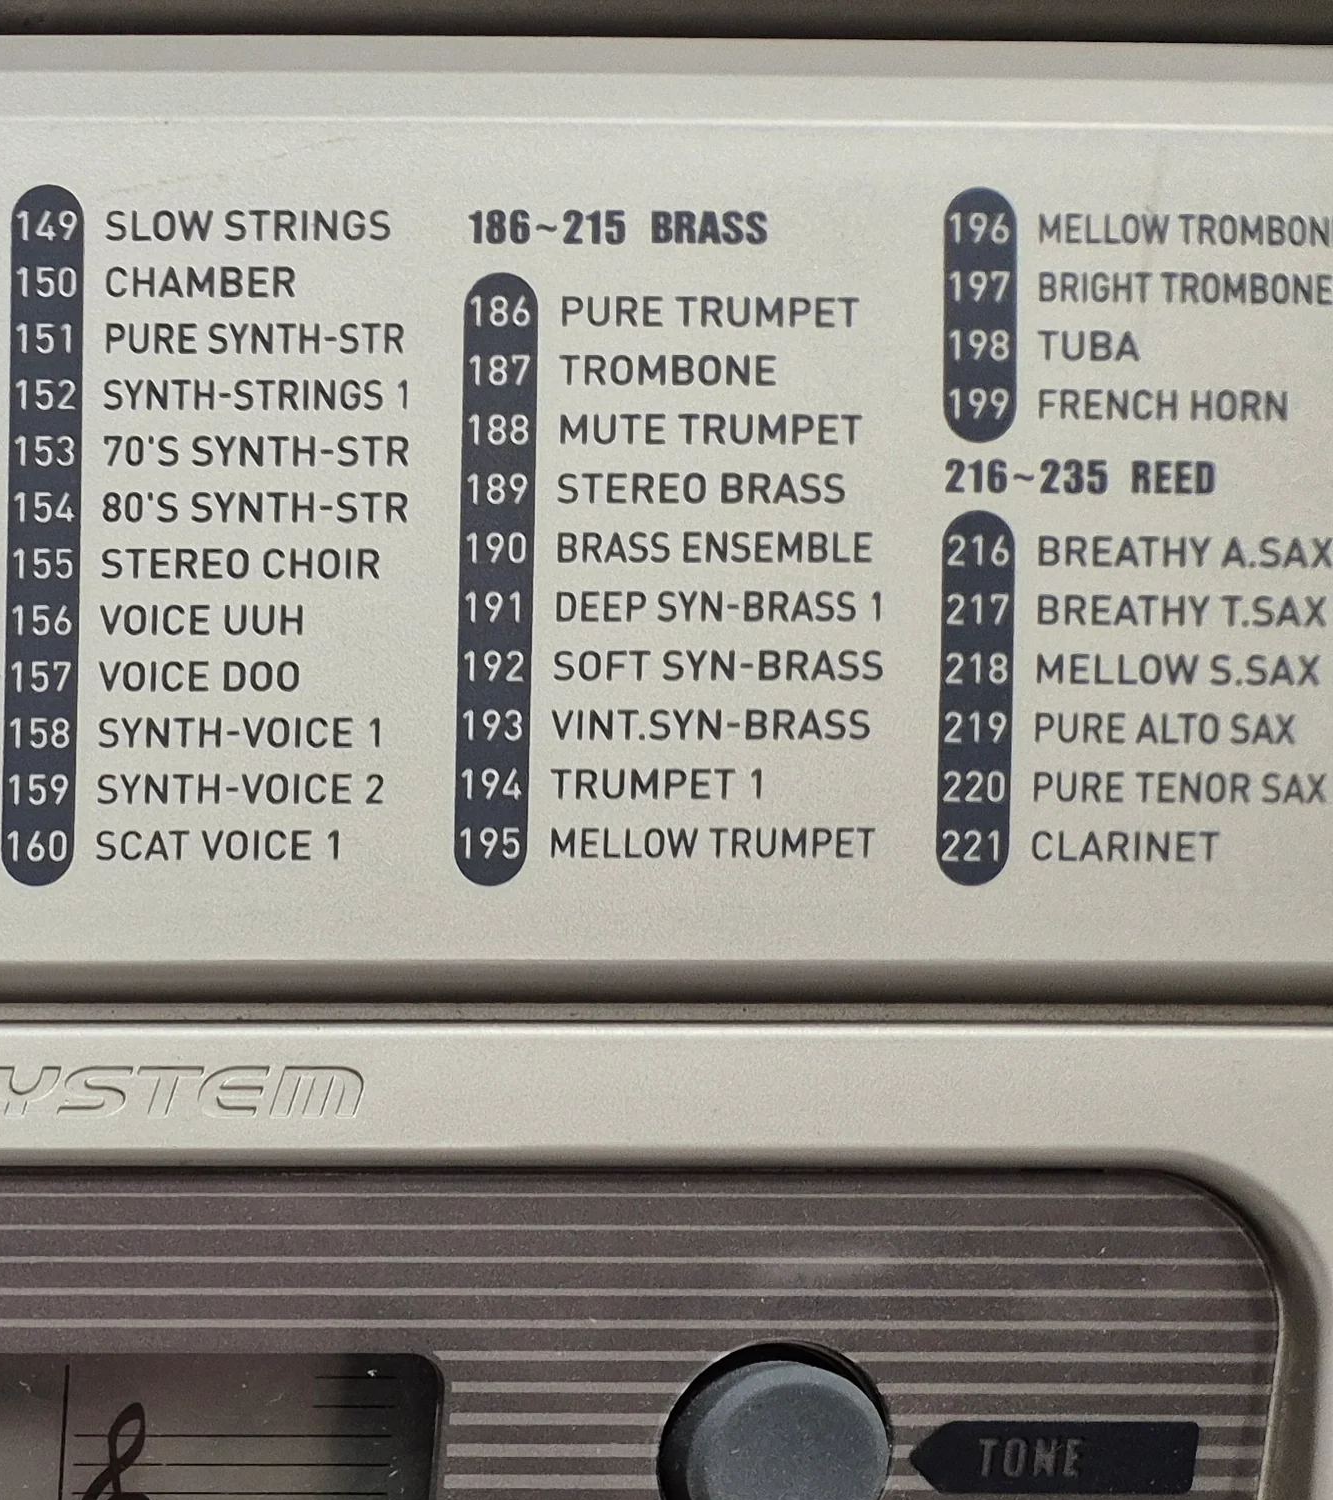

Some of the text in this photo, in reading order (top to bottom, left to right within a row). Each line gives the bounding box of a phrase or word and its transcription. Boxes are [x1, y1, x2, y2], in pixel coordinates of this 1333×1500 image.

[468, 209, 768, 245] 186~215 BRASS
[16, 266, 295, 298] 150 CHAMBER
[949, 329, 1140, 362] 198 TUBA
[469, 354, 776, 387] 187 TROMBONE
[945, 458, 1215, 495] 216~235 REED
[945, 652, 1320, 686] 218 MELLOW S.SAX
[7, 829, 340, 862] 160 SCAT VOICE 1
[460, 827, 875, 859] 195 MELLOW TRUMPET
[941, 829, 1220, 863] 221 CLARINET
[979, 1438, 1081, 1477] TONE
